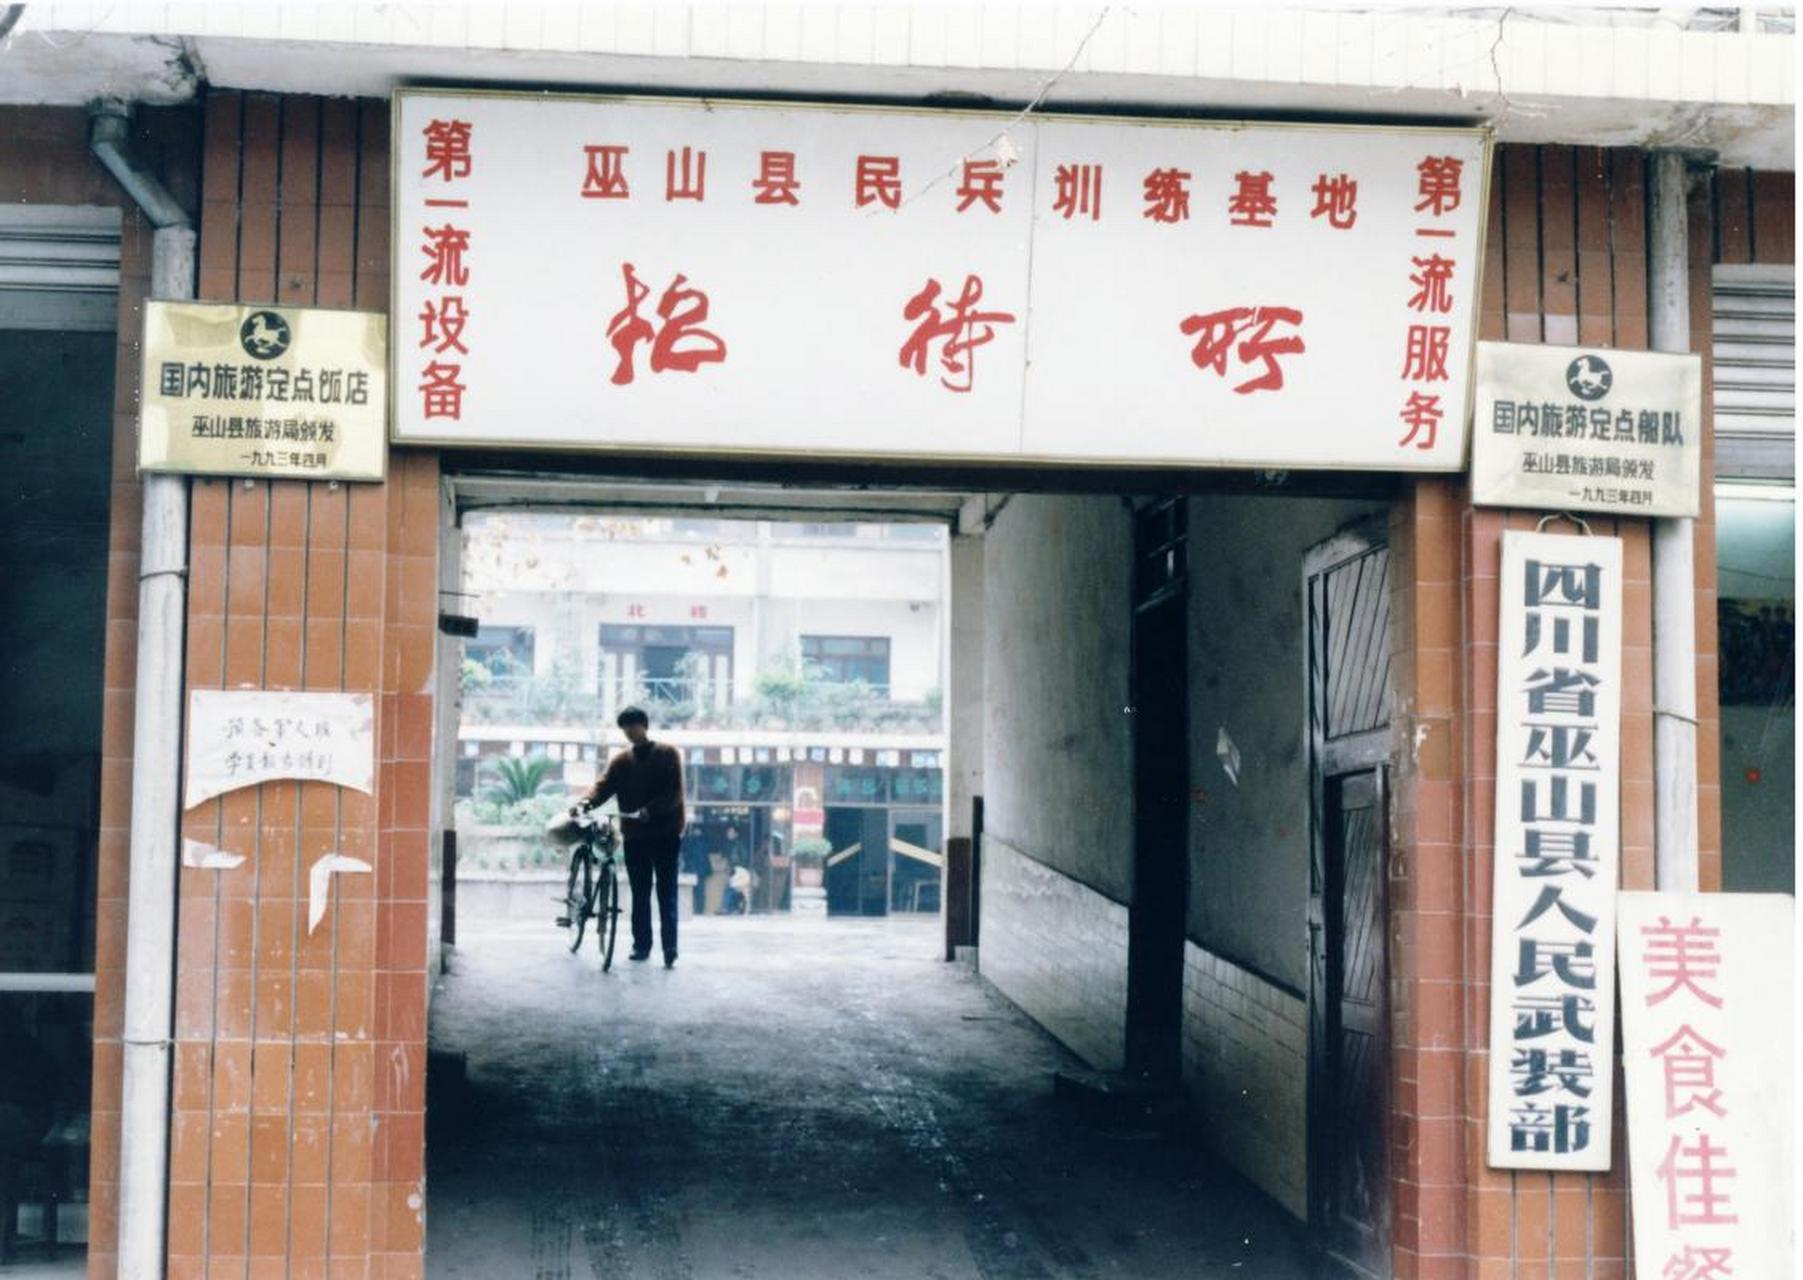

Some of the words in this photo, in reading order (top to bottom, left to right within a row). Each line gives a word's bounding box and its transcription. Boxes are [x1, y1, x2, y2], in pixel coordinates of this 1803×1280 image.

[1399, 155, 1465, 451] 第一流服务
[606, 262, 1305, 394] 招待所
[161, 362, 368, 404] 国内旅游定点饭店
[192, 415, 335, 442] 巫山县旅游局颁发
[1494, 401, 1683, 445] 国内旅游定点船队
[240, 451, 328, 468] 一九九三年四月
[1523, 453, 1653, 480] 巫山县旅游局颁发
[1568, 487, 1653, 505] 一九九三年四月
[1508, 559, 1604, 1154] 四川省巫山县人民武装部
